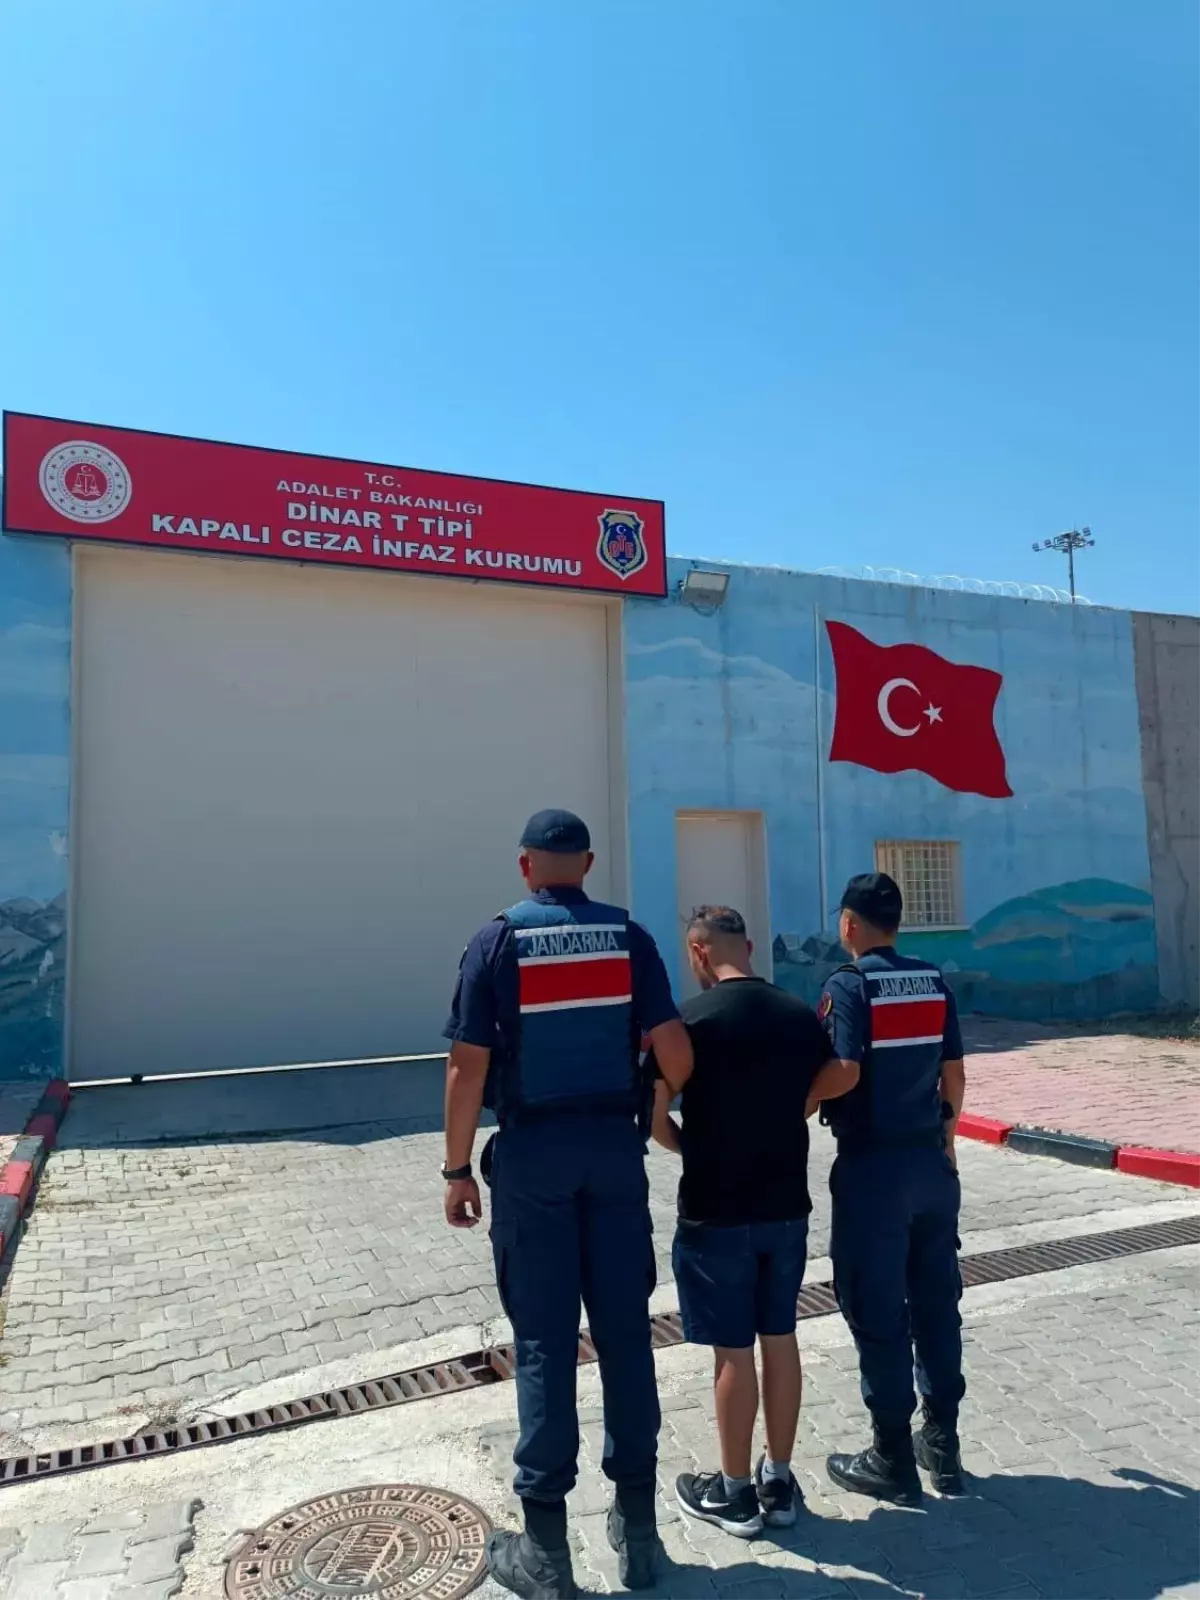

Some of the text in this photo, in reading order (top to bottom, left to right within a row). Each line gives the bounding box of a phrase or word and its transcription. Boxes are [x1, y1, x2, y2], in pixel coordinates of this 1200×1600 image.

[276, 480, 362, 501] ADALET
[364, 472, 401, 488] T.C.
[288, 501, 473, 540] DİNAR T TİPİ
[151, 513, 582, 577] KAPALI CEZA İNFAZ KURUMU
[527, 930, 619, 957] JANDARMA
[878, 975, 938, 997] JANDARMA
